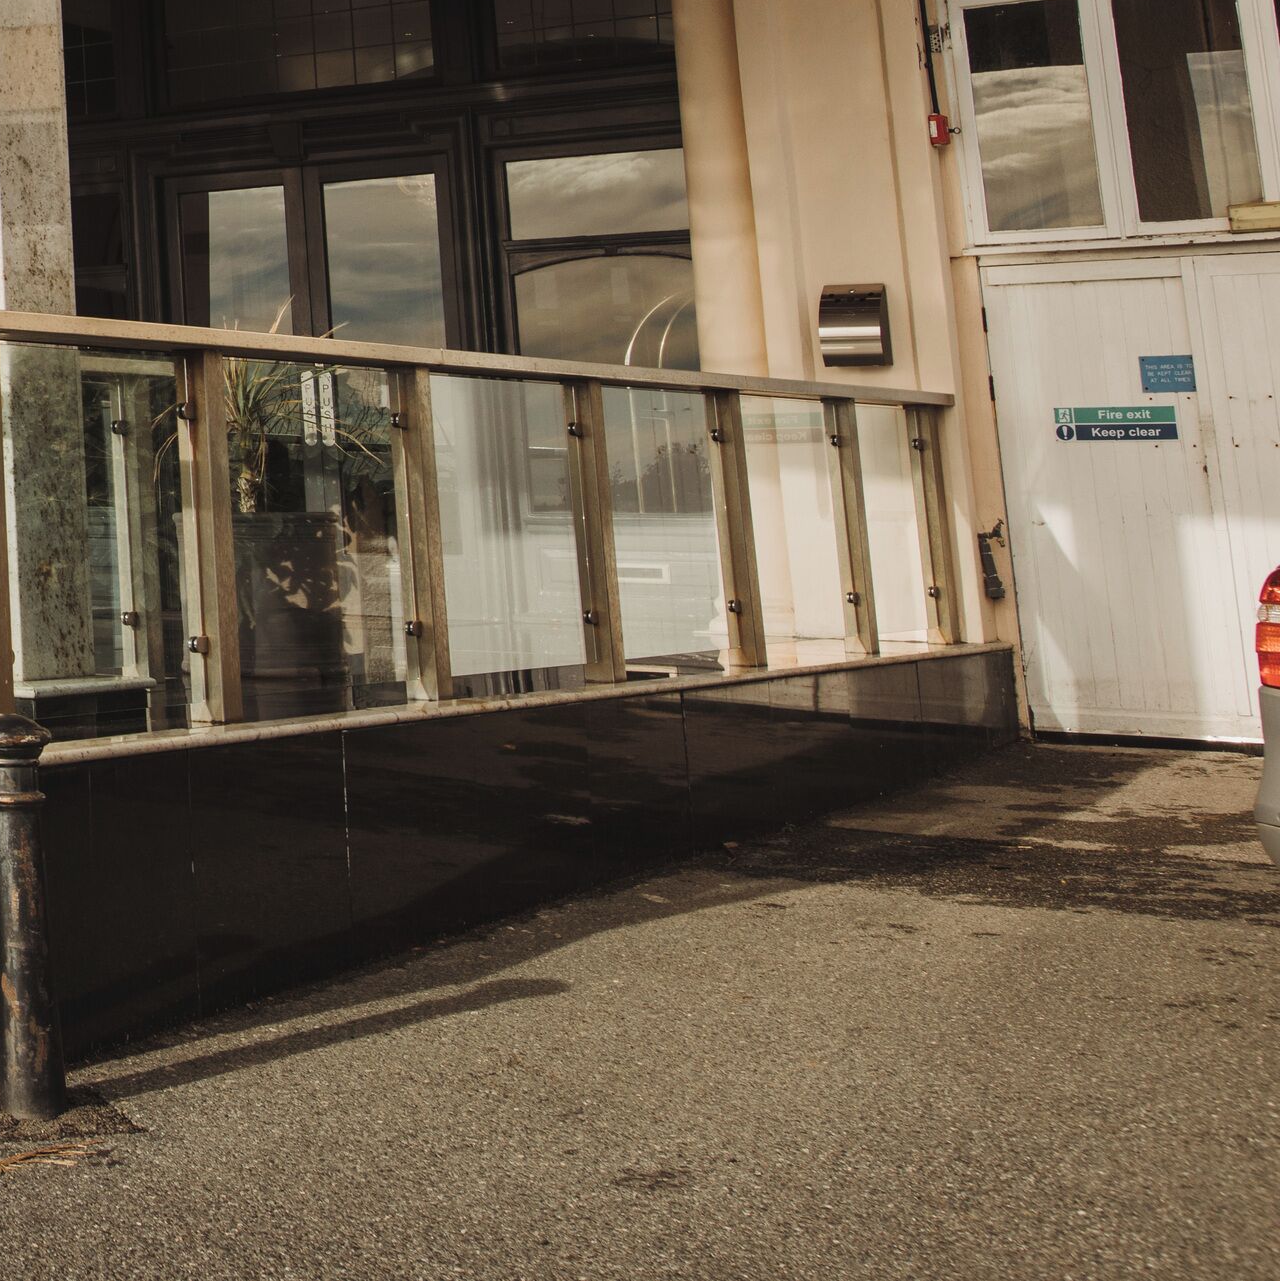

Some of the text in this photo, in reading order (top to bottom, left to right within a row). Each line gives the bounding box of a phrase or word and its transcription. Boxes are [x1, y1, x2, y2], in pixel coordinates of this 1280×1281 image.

[322, 384, 333, 433] PUSH
[1098, 410, 1151, 419] Fire exit
[1092, 427, 1161, 438] Keep clear
